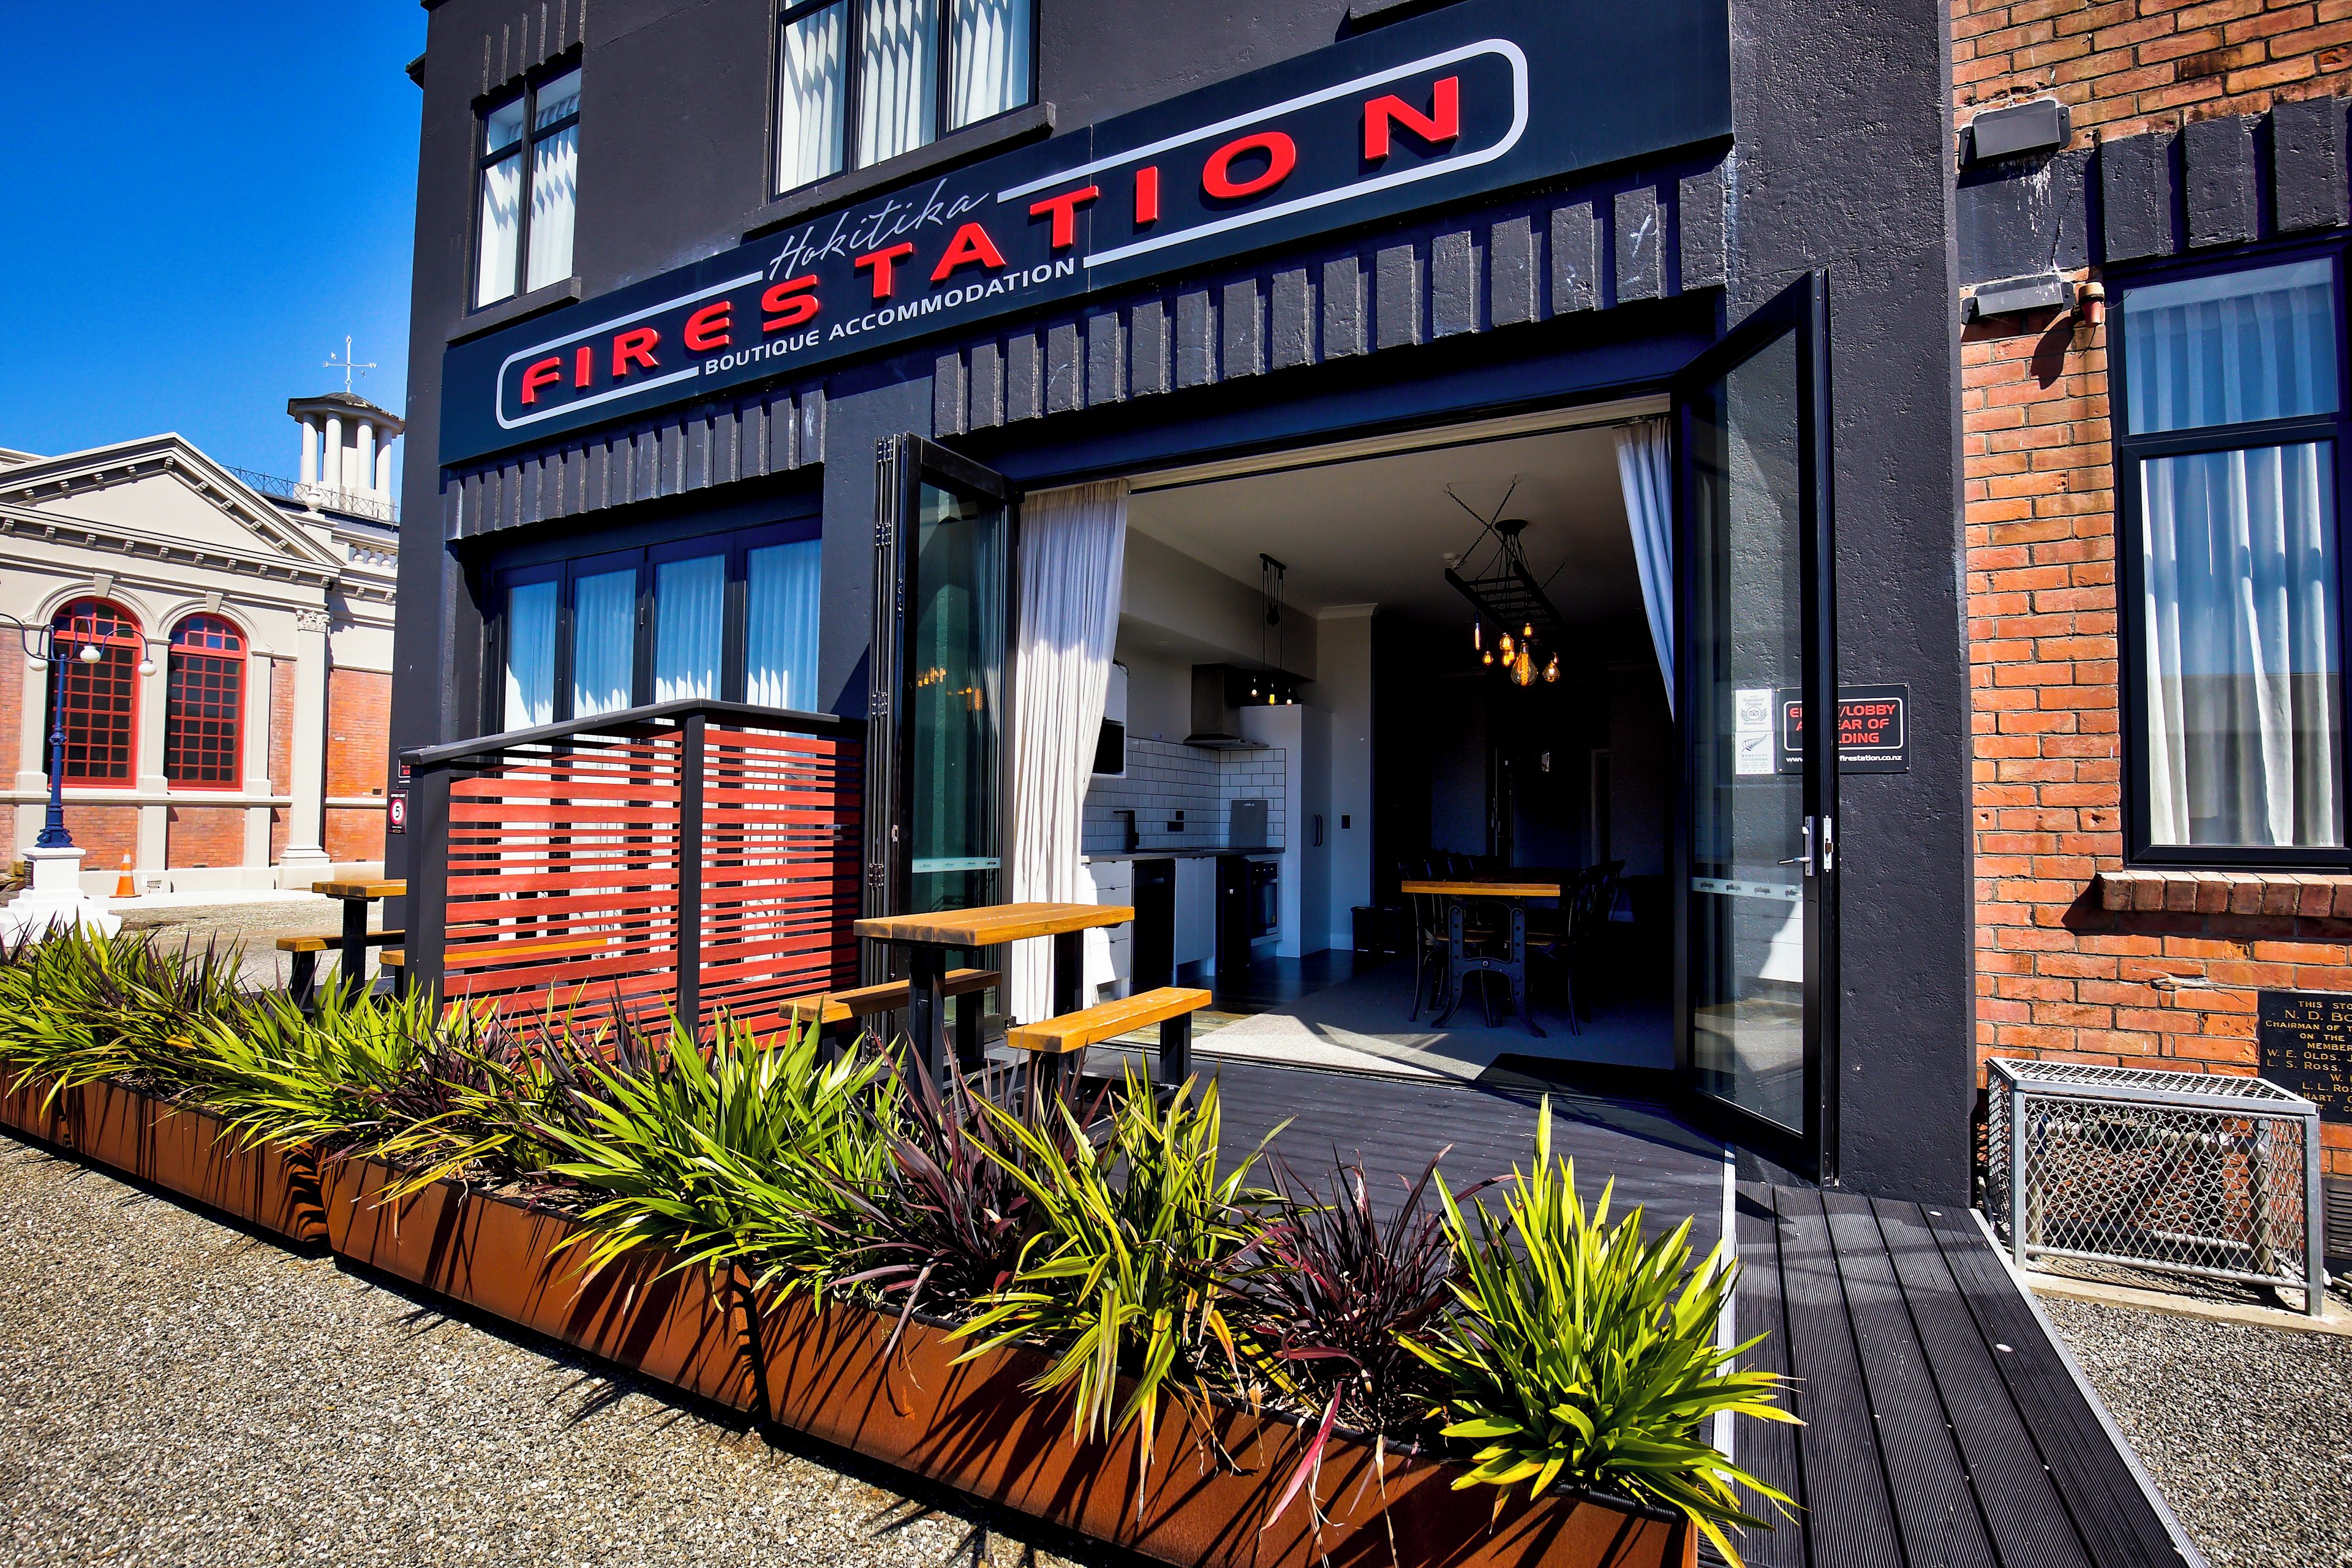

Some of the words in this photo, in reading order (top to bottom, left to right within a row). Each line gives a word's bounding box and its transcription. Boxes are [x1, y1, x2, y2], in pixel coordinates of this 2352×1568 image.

[769, 177, 990, 281] Hokitika
[704, 329, 820, 377] BOUTIQUE
[828, 257, 1075, 341] ACCOMMODATION
[1790, 704, 1896, 718] E/LOBBY
[1868, 718, 1890, 729] OF
[395, 805, 400, 818] 5
[2285, 1009, 2299, 1019] N.
[2308, 1011, 2323, 1020] D.
[2307, 1042, 2352, 1051] MEMBER
[2286, 1050, 2297, 1058] E.
